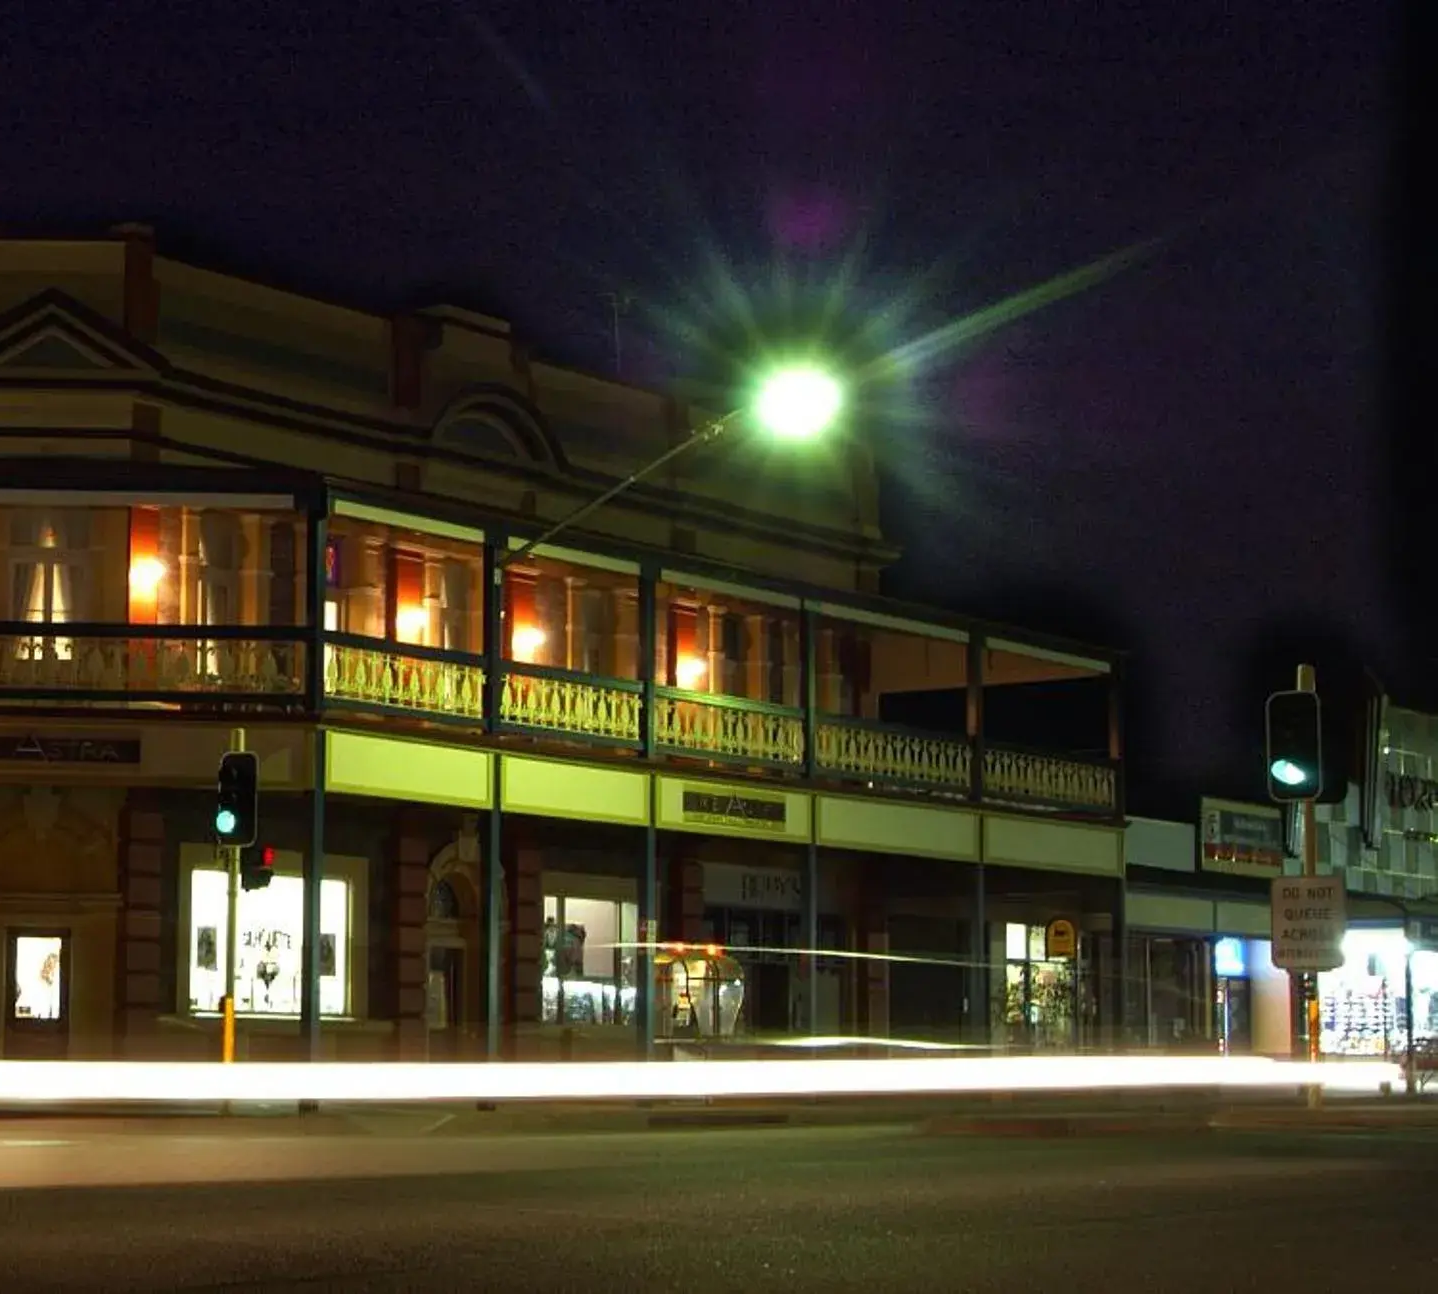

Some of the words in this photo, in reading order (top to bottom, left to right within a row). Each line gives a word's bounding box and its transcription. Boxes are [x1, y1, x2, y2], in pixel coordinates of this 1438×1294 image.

[1282, 886, 1300, 900] DO
[1307, 886, 1335, 900] NOT
[1284, 907, 1332, 921] QUEUE
